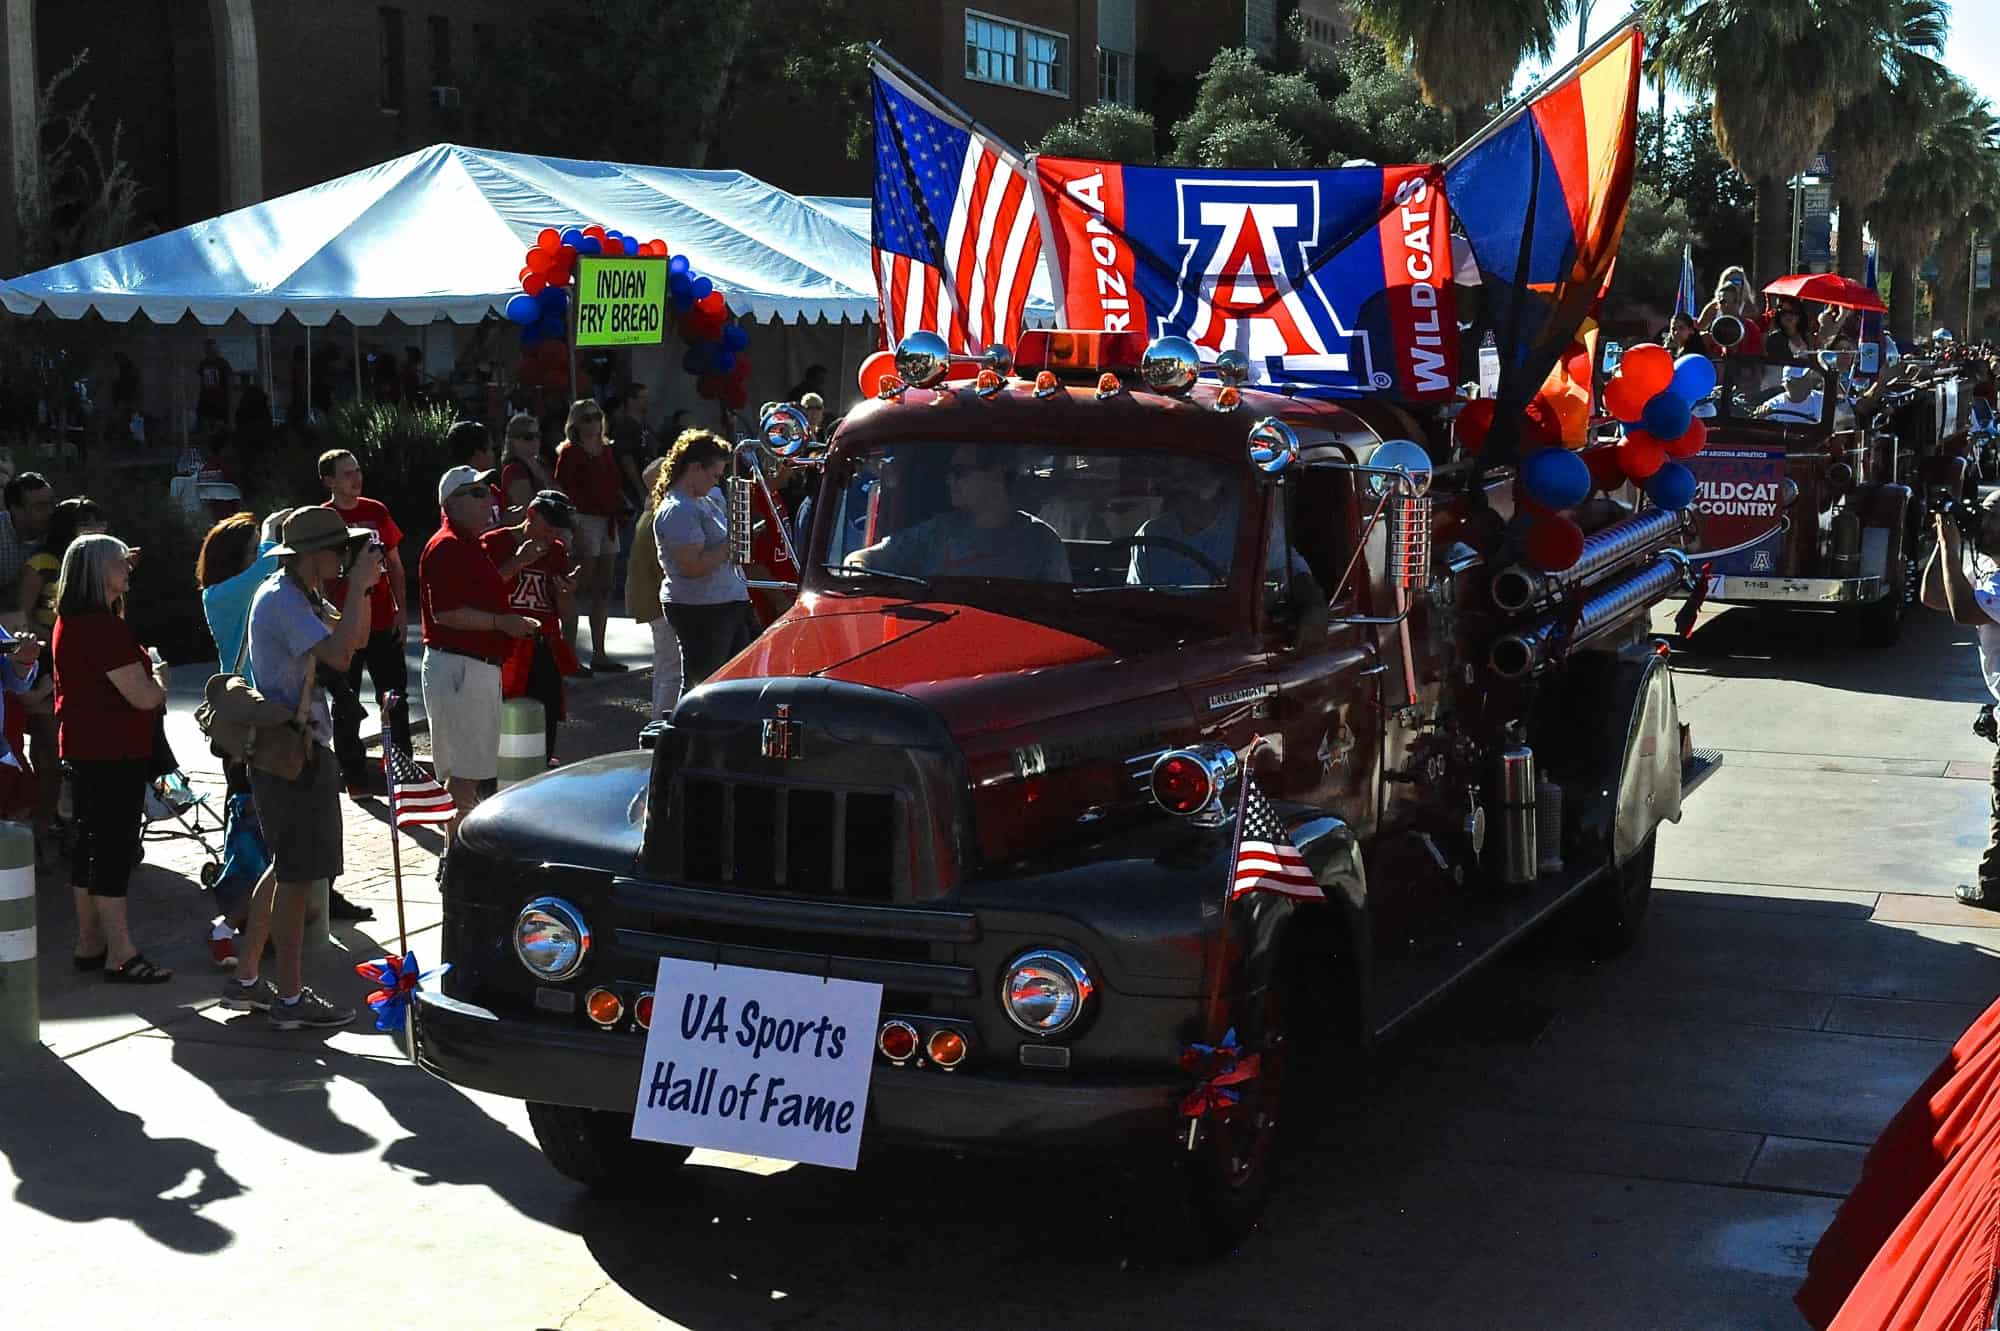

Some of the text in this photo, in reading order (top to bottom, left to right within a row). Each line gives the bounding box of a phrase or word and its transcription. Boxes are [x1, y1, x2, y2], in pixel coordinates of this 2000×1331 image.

[1065, 173, 1130, 332] RIZONA
[596, 269, 647, 299] INDIAN
[1393, 175, 1451, 393] WILDCATS
[579, 303, 660, 334] FRY BREAD
[1699, 501, 1777, 517] COUNTRY
[509, 570, 552, 612] A
[681, 992, 846, 1059] UA Sports
[647, 1061, 855, 1134] Hall of Fame
